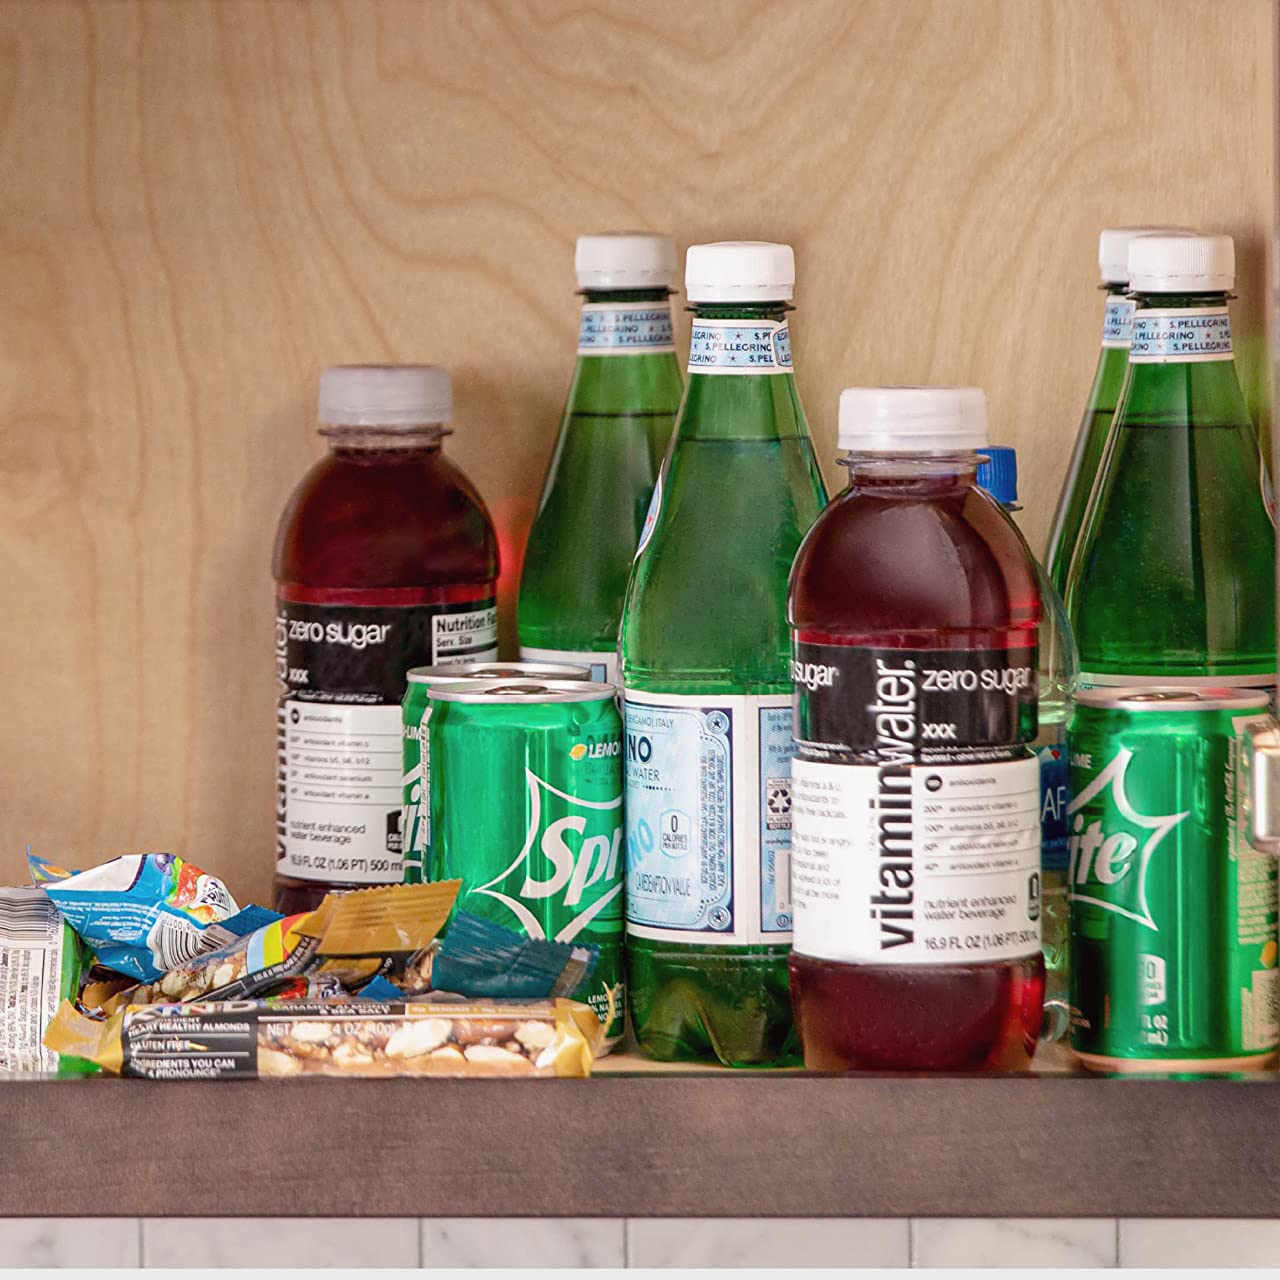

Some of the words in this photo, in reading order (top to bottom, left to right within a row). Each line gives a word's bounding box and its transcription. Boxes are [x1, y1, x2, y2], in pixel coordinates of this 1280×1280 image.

[436, 615, 487, 633] Nutrition
[289, 619, 324, 642] zero
[326, 622, 391, 650] sugar
[795, 662, 836, 691] sugar
[922, 669, 978, 692] zero
[980, 667, 1031, 695] sugar
[921, 722, 956, 740] xxx
[633, 769, 660, 782] WATER
[869, 658, 916, 952] vitaminwater.
[670, 815, 678, 832] 0
[370, 860, 389, 871] 500
[159, 1022, 201, 1032] HEALTHY
[203, 1022, 250, 1032] ALMONDS
[267, 1023, 290, 1036] NET
[192, 1058, 214, 1069] YOU
[214, 1058, 236, 1069] CAN
